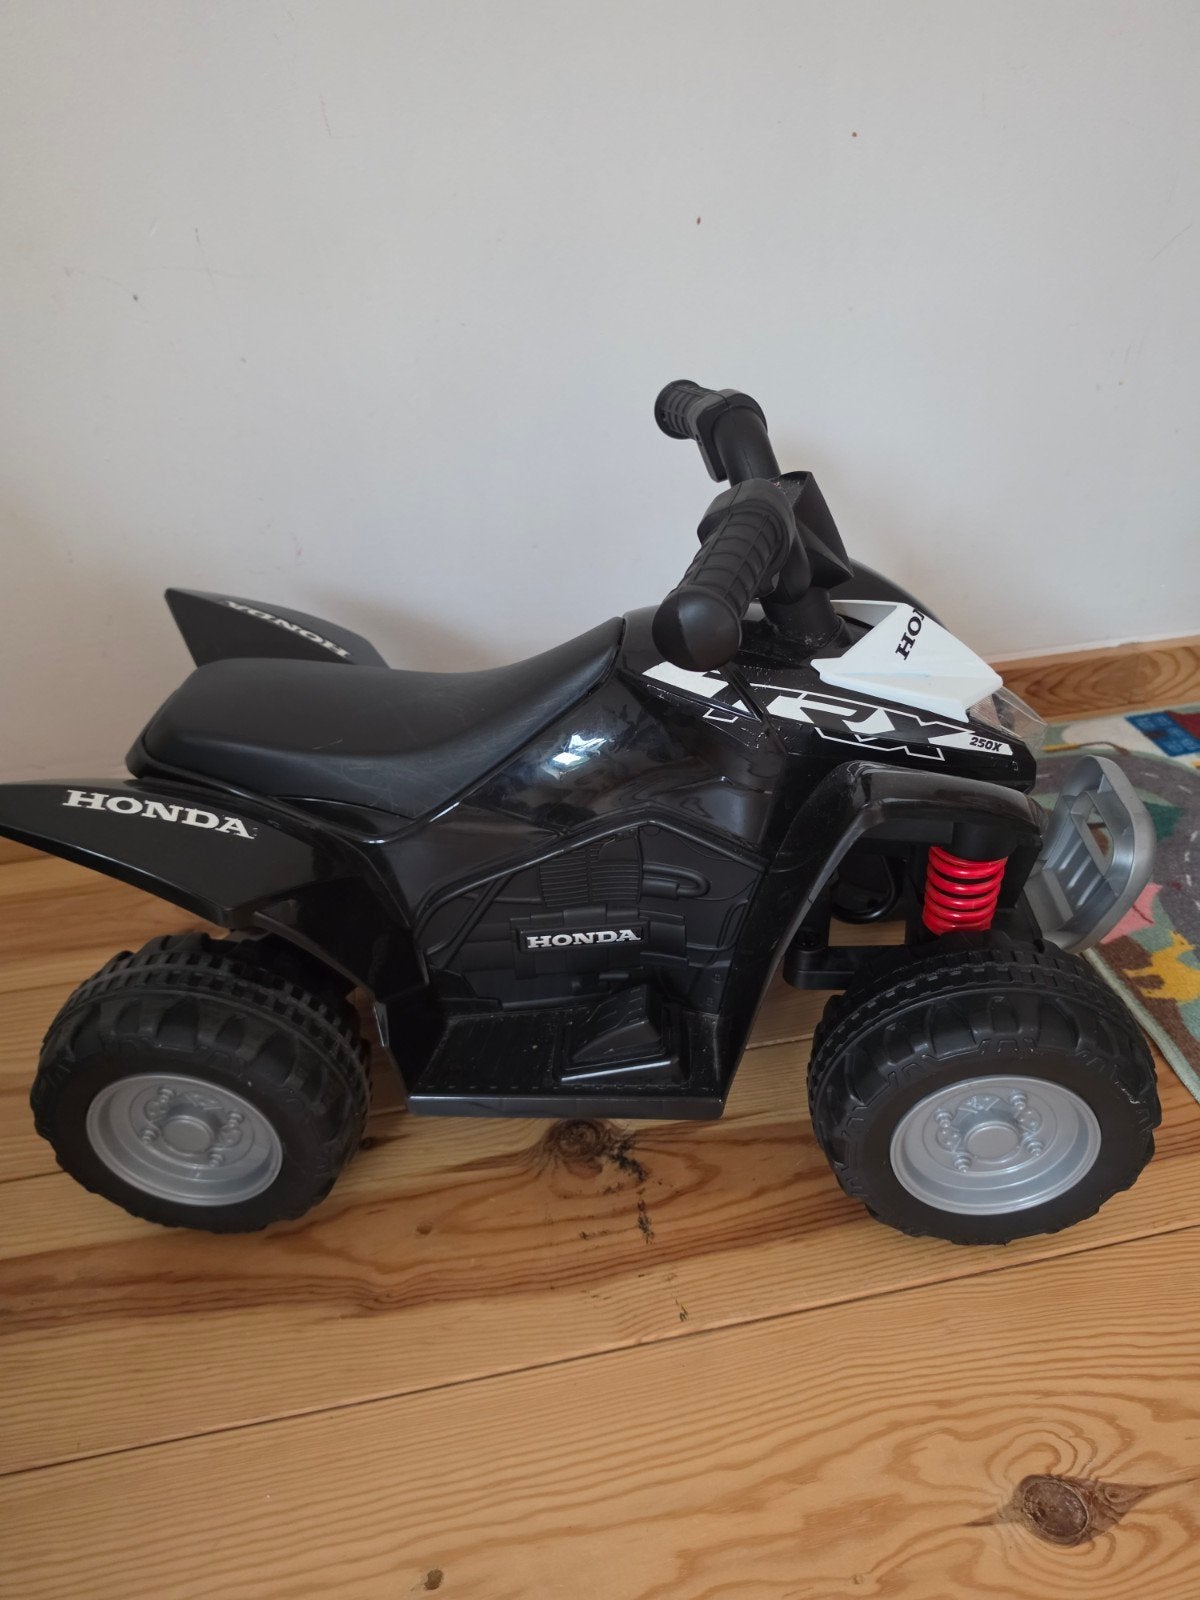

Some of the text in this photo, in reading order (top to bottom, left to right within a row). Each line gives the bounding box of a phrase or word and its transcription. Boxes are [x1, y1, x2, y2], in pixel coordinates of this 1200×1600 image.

[969, 736, 1003, 752] 250X
[62, 790, 254, 839] HONDA
[526, 929, 641, 949] HONDA
